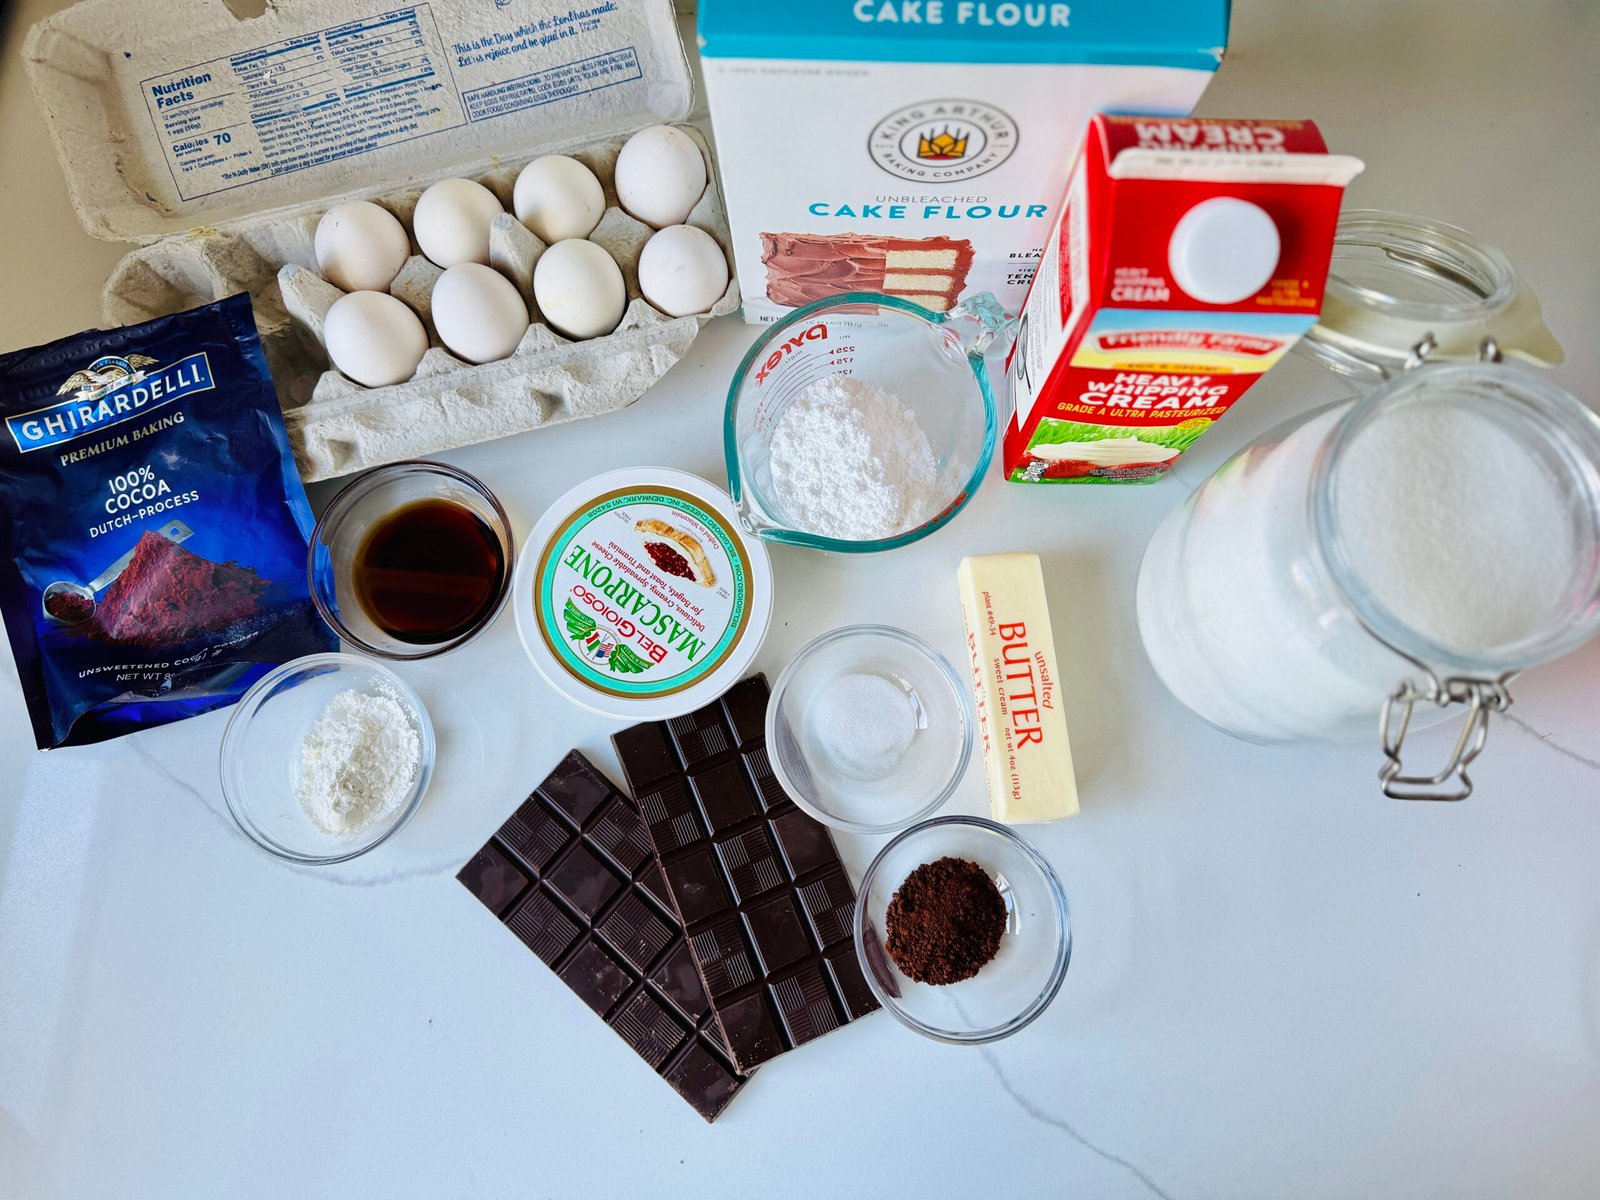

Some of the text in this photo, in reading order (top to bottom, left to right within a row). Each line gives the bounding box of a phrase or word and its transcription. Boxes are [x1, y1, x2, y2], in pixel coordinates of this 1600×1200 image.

[853, 0, 1071, 27] CAKE FLOUR
[451, 40, 471, 55] This
[471, 39, 480, 50] is
[479, 34, 493, 47] the
[492, 29, 513, 45] Day
[512, 22, 538, 37] which
[537, 17, 552, 30] the
[551, 11, 574, 26] Lord
[573, 7, 591, 20] has
[345, 38, 383, 52] Carbohydrate
[456, 54, 471, 67] Let
[472, 54, 484, 63] us
[483, 45, 511, 62] rejoice
[509, 38, 527, 52] and
[527, 36, 539, 47] be
[538, 29, 559, 46] glad
[558, 28, 567, 38] in
[151, 71, 211, 96] Nutrition
[480, 86, 505, 98] HANDLING
[155, 89, 194, 108] Facts
[483, 97, 498, 106] EGGS
[164, 114, 200, 129] Serving size
[172, 127, 184, 135] egg
[881, 106, 1009, 140] KING ARTHUR
[212, 131, 232, 146] 70
[1136, 124, 1285, 145] CREAM
[883, 152, 998, 178] BAKING COMPANY
[876, 195, 988, 204] UNBLEACHED
[808, 202, 1048, 219] CAKE FLOUR
[1087, 381, 1229, 396] WHIPPING
[1114, 373, 1212, 386] HEAVY
[21, 363, 203, 442] GHIRARDELLI
[1057, 402, 1227, 418] GRADE A ULTRA PASTEURIZED
[1079, 391, 1220, 409] CREAM
[60, 411, 185, 467] PREMIUM BAKING
[107, 464, 156, 495] 100%
[104, 478, 172, 515] COCOA
[89, 490, 200, 539] DUTCH-PROCESS
[681, 502, 708, 520] CHEESE
[704, 530, 720, 550] Crafted
[707, 518, 737, 558] BELGIOIOSO
[638, 563, 651, 574] and
[591, 541, 705, 632] Delicious, Creamy, Spreadable Cheese
[649, 572, 667, 590] Toast
[564, 545, 706, 661] MASCARPONE
[668, 586, 694, 608] Bagels,
[981, 591, 992, 609] plant
[691, 602, 704, 615] for
[78, 662, 170, 678] UNSWEETENED
[116, 672, 140, 681] NET
[143, 672, 162, 681] WT
[1034, 650, 1054, 710] unsalted
[993, 657, 1008, 716] sweet cream
[998, 621, 1044, 750] BUTTER
[1004, 727, 1022, 801] net wt 4oz (113g)
